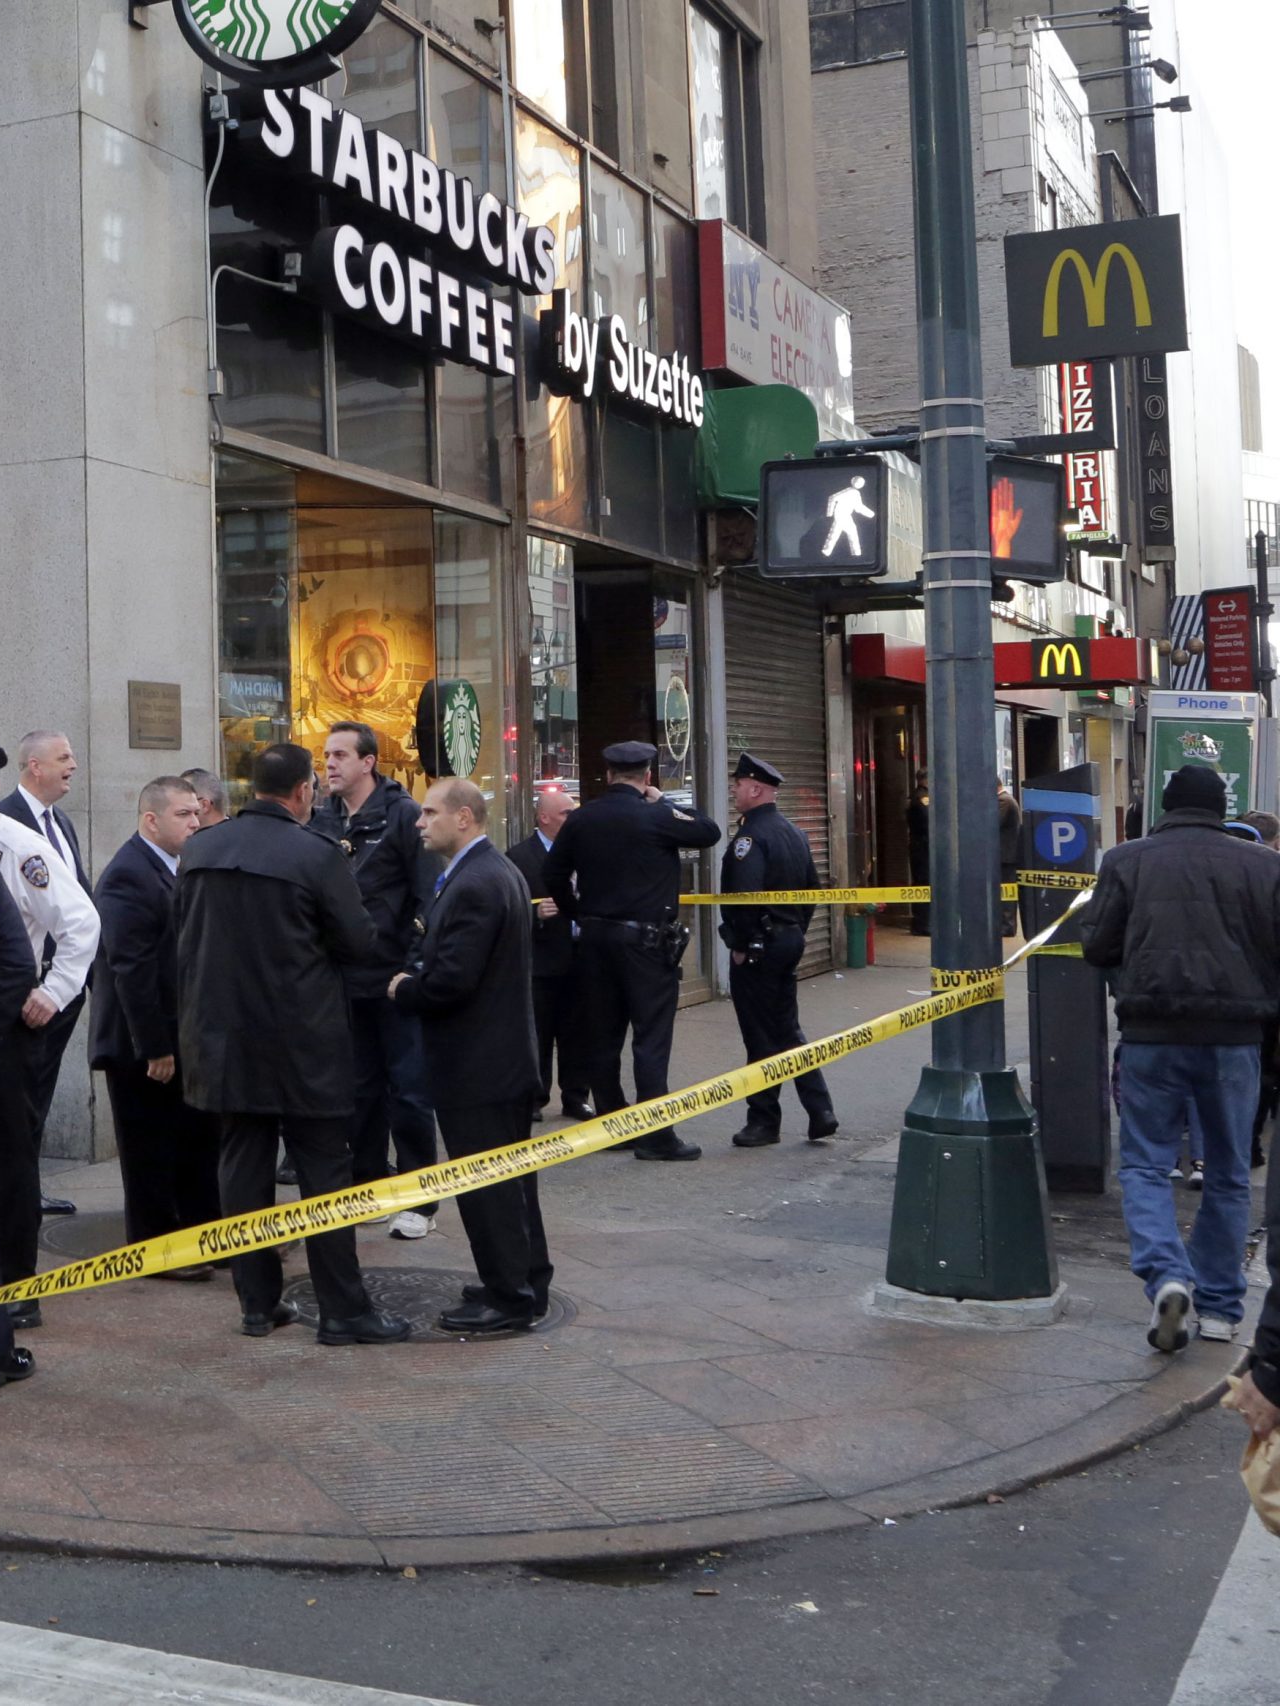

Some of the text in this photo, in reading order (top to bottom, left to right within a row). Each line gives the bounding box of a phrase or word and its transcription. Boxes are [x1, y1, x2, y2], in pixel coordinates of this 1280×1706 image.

[261, 87, 556, 295] STARBUCKS
[333, 224, 516, 376] COFFEE
[563, 291, 704, 428] by Suzette
[1072, 365, 1100, 525] IZZRIA
[1143, 357, 1170, 532] LOANS
[1178, 697, 1228, 709] Phone
[1051, 822, 1076, 857] P
[1025, 873, 1054, 886] LINE
[1057, 876, 1076, 887] DO
[1081, 878, 1097, 888] NO
[898, 981, 995, 1030] POLICE LINE DO NOT CROSS
[941, 974, 961, 987] DO
[760, 1027, 873, 1084] POLICE LINE DO NOT CROSS
[602, 1079, 733, 1140] POLICE LINE DO NOT CROSS
[418, 1135, 574, 1196] POLICE LINE DO NOT CROSS
[198, 1189, 382, 1256] POLICE LINE DO NOT CROSS
[25, 1274, 54, 1298] DO
[54, 1261, 95, 1291] NOT
[92, 1246, 147, 1282] CROSS
